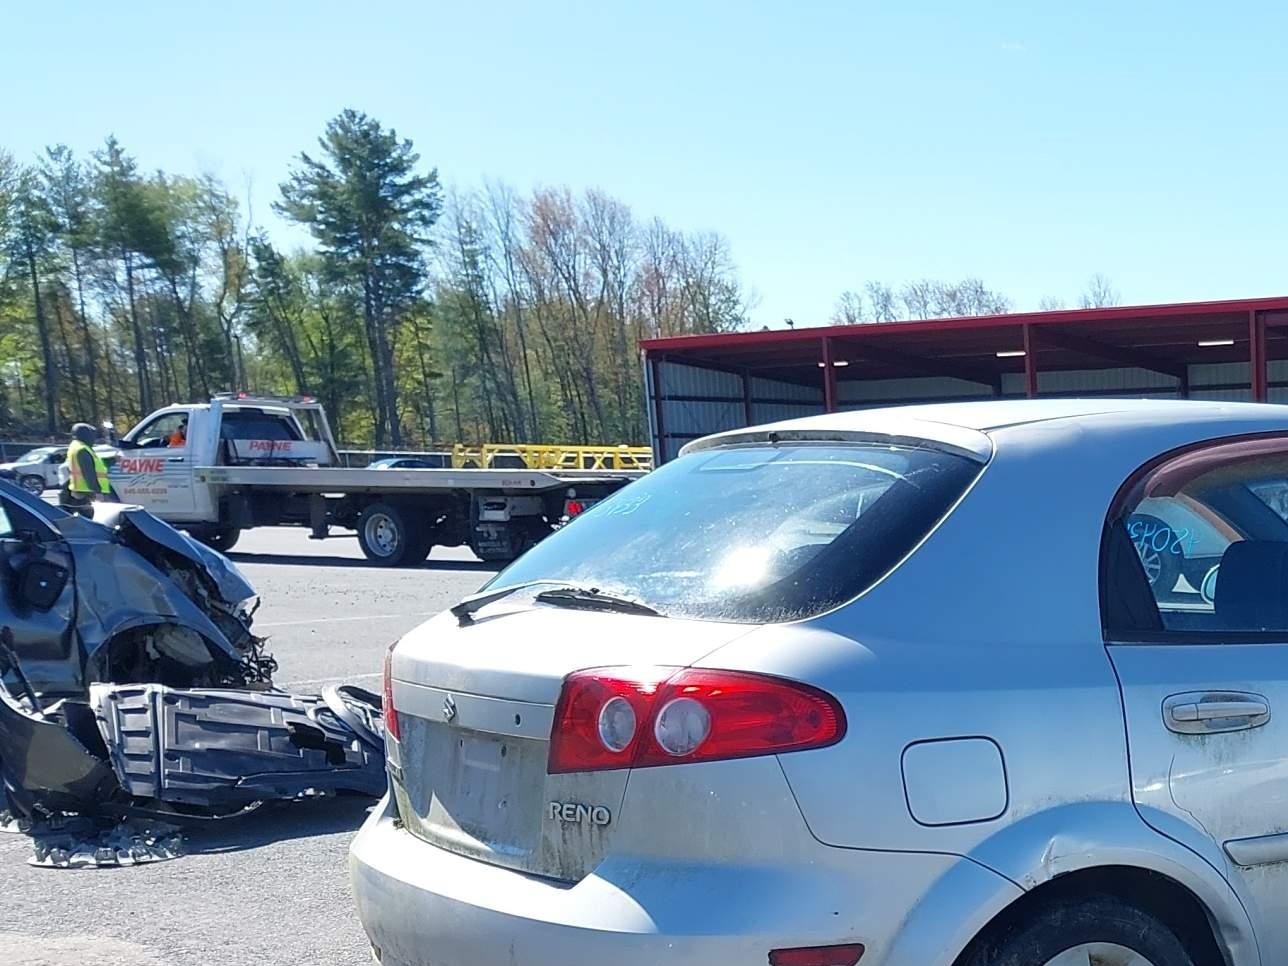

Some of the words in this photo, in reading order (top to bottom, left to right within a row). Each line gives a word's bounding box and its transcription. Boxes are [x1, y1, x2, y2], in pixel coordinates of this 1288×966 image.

[249, 441, 293, 451] PAYNE
[121, 458, 165, 473] PAYNE
[549, 801, 611, 825] RENO
